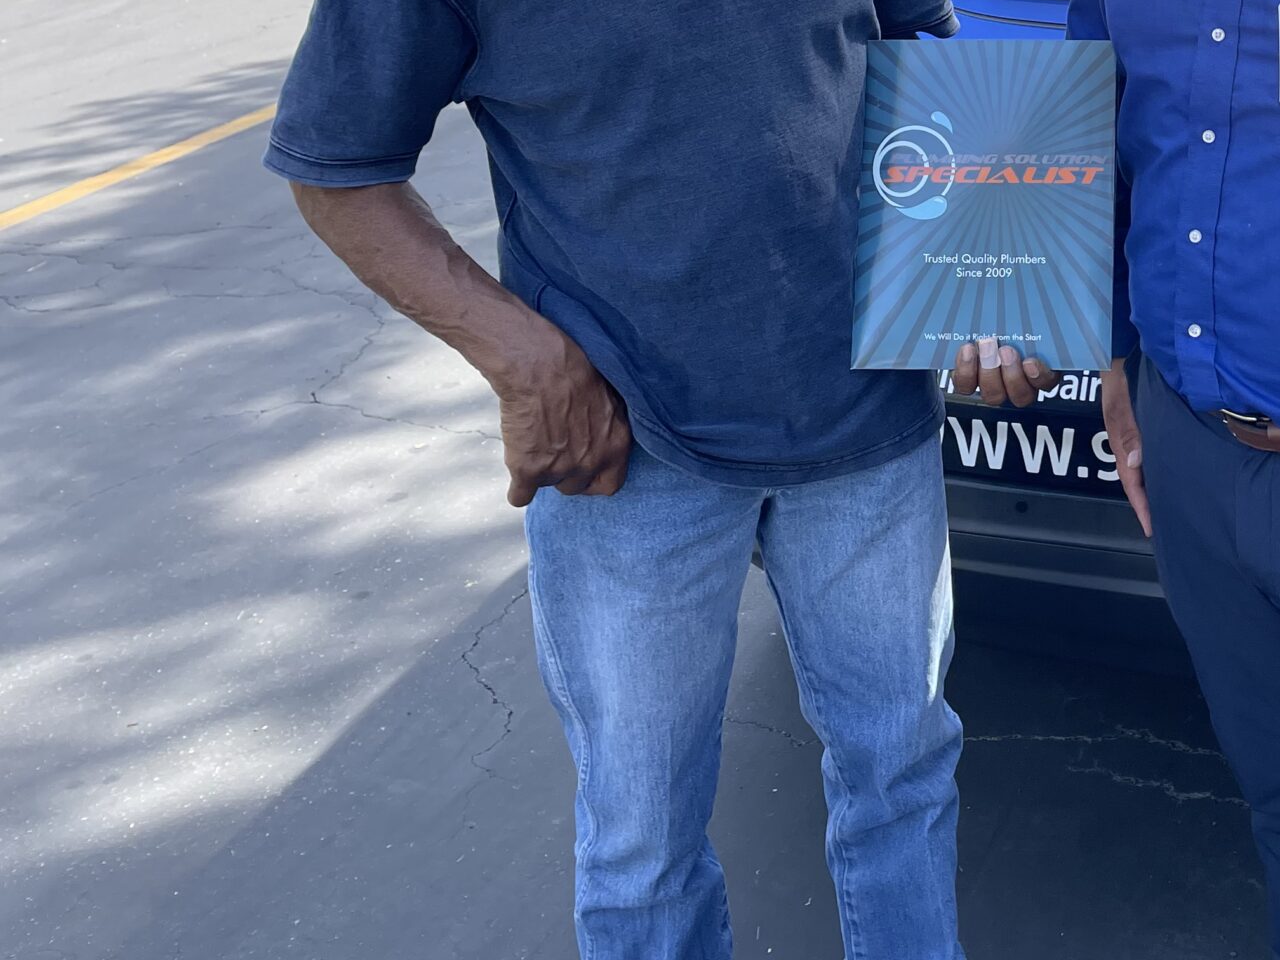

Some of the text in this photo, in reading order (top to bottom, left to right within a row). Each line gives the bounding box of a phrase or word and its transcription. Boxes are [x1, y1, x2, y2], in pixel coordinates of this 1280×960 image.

[1002, 153, 1107, 165] SOLUTION
[883, 165, 1105, 185] SPECIALIST
[923, 253, 1046, 266] Trusted Quality Plumbers
[956, 267, 1013, 278] Since 2009
[924, 333, 936, 341] We
[937, 332, 952, 341] Will
[953, 333, 965, 341] Do
[1012, 333, 1024, 341] the
[1024, 333, 1042, 341] Start
